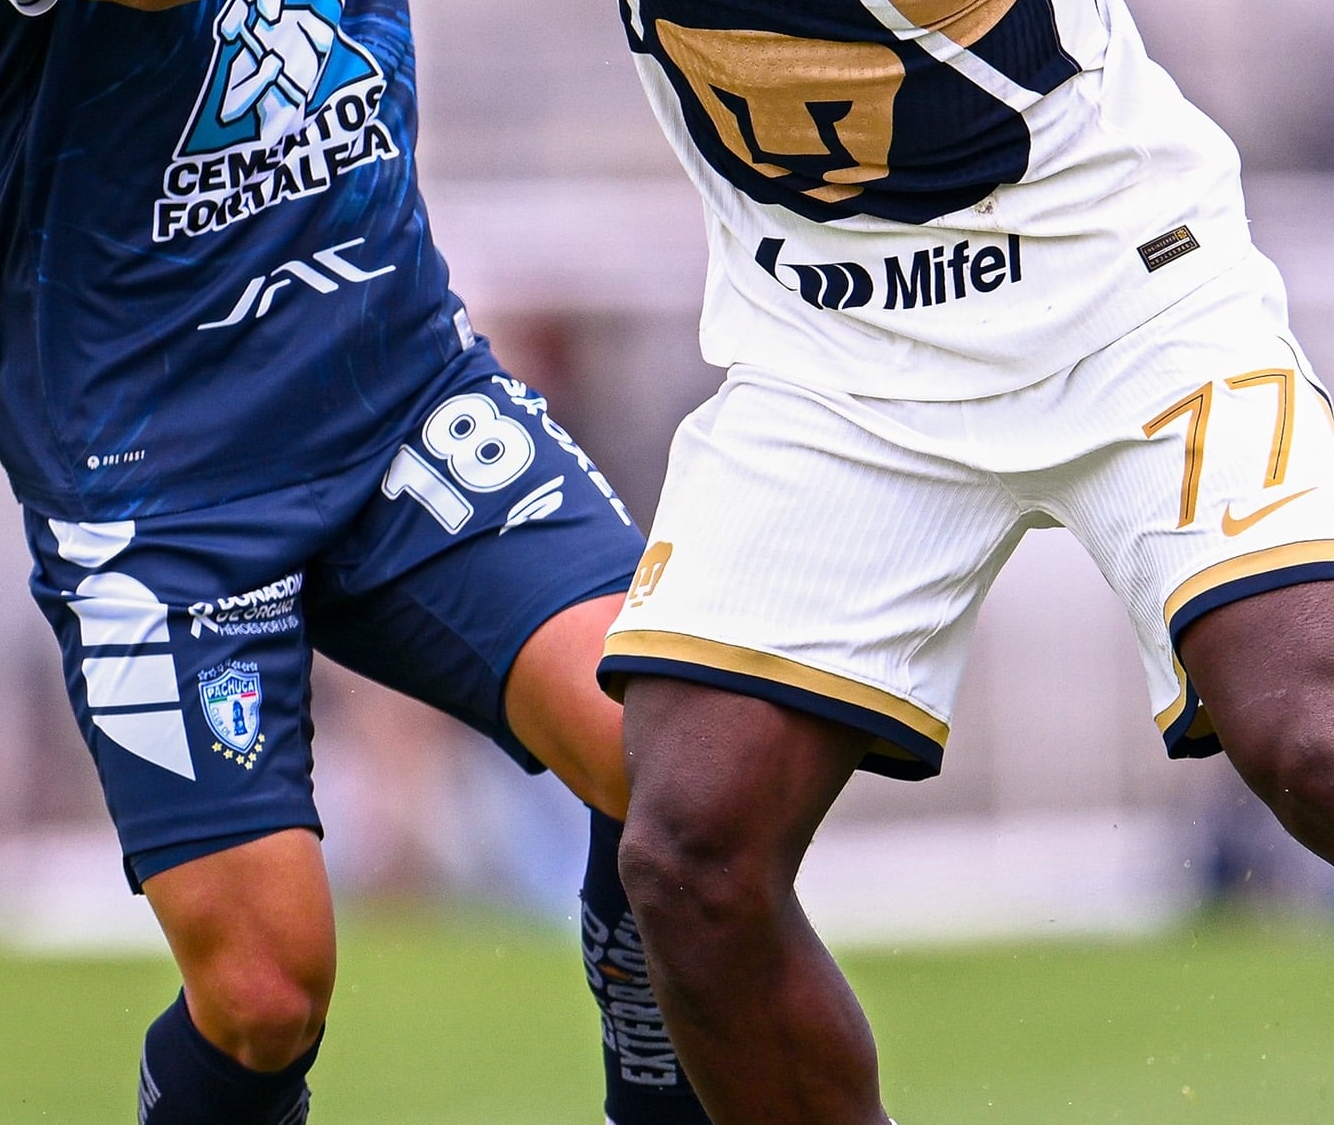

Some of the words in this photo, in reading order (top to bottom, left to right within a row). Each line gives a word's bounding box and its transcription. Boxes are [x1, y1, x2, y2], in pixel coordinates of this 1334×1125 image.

[196, 237, 397, 331] JAC
[883, 234, 1022, 310] Mifel
[381, 393, 535, 535] 18
[1141, 368, 1295, 530] 77
[207, 679, 255, 699] PACHUCA
